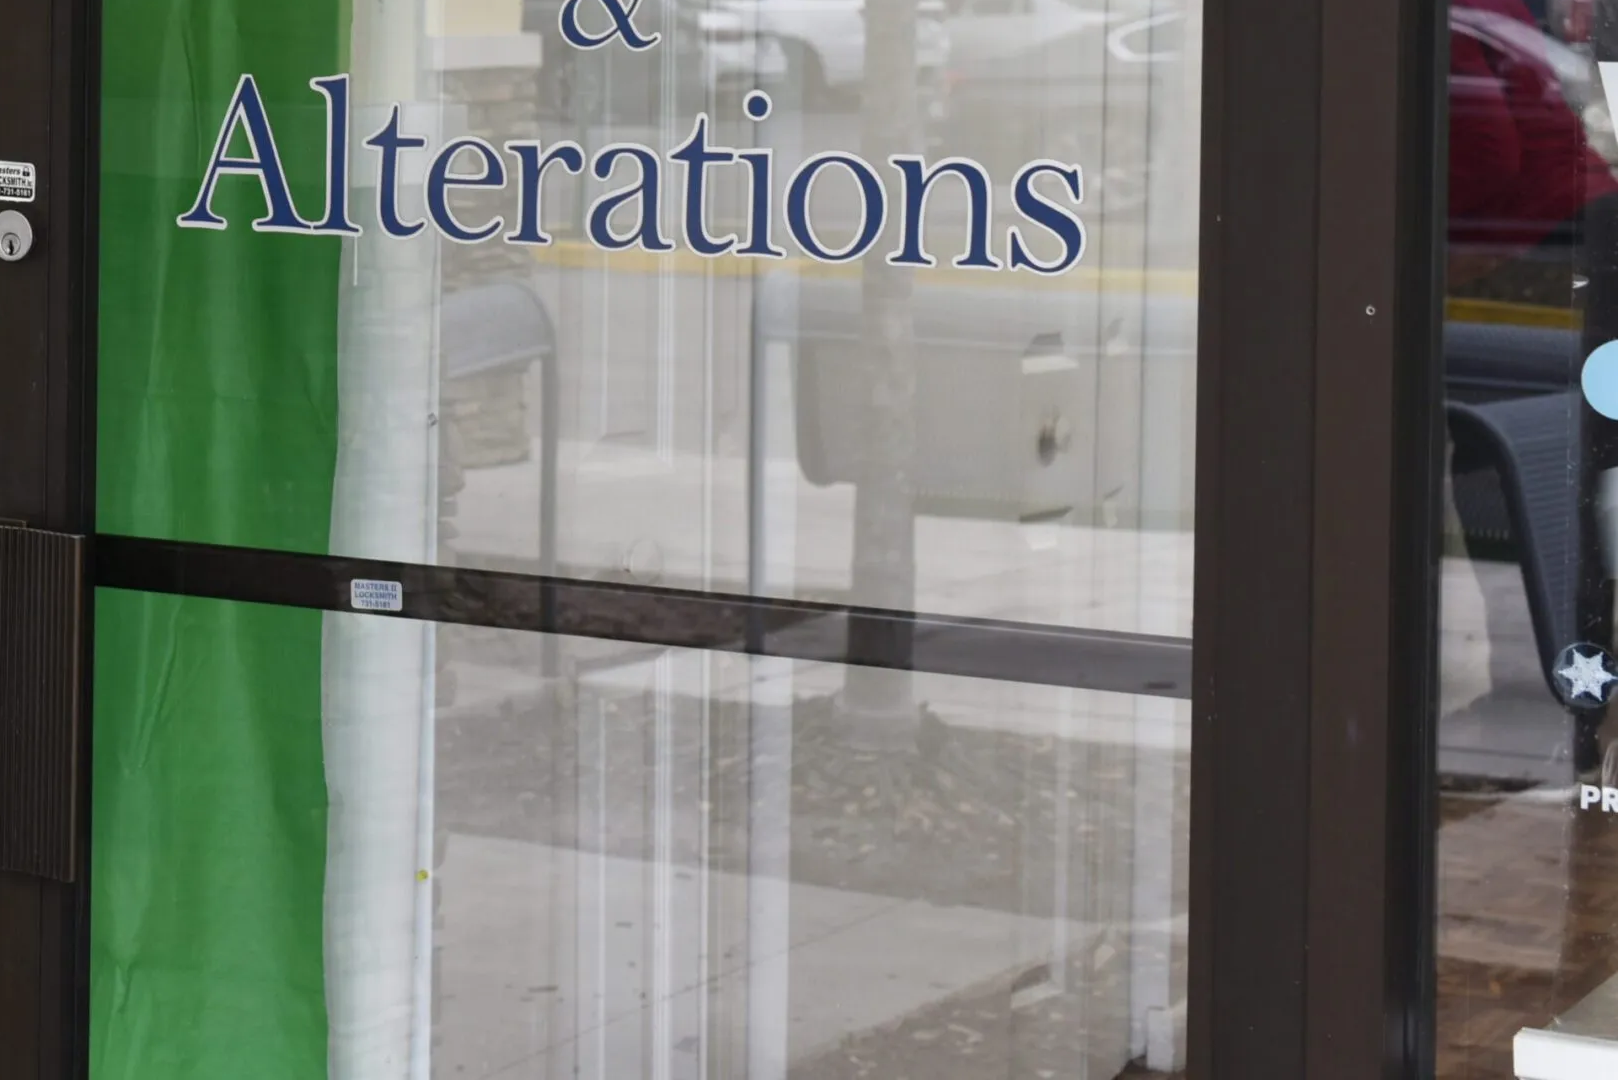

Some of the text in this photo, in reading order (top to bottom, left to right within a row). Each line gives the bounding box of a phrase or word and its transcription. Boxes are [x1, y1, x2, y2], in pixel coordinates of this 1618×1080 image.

[177, 73, 1086, 274] Alterations
[354, 582, 389, 591] MASTERS
[354, 591, 397, 600] LOCKSMITH
